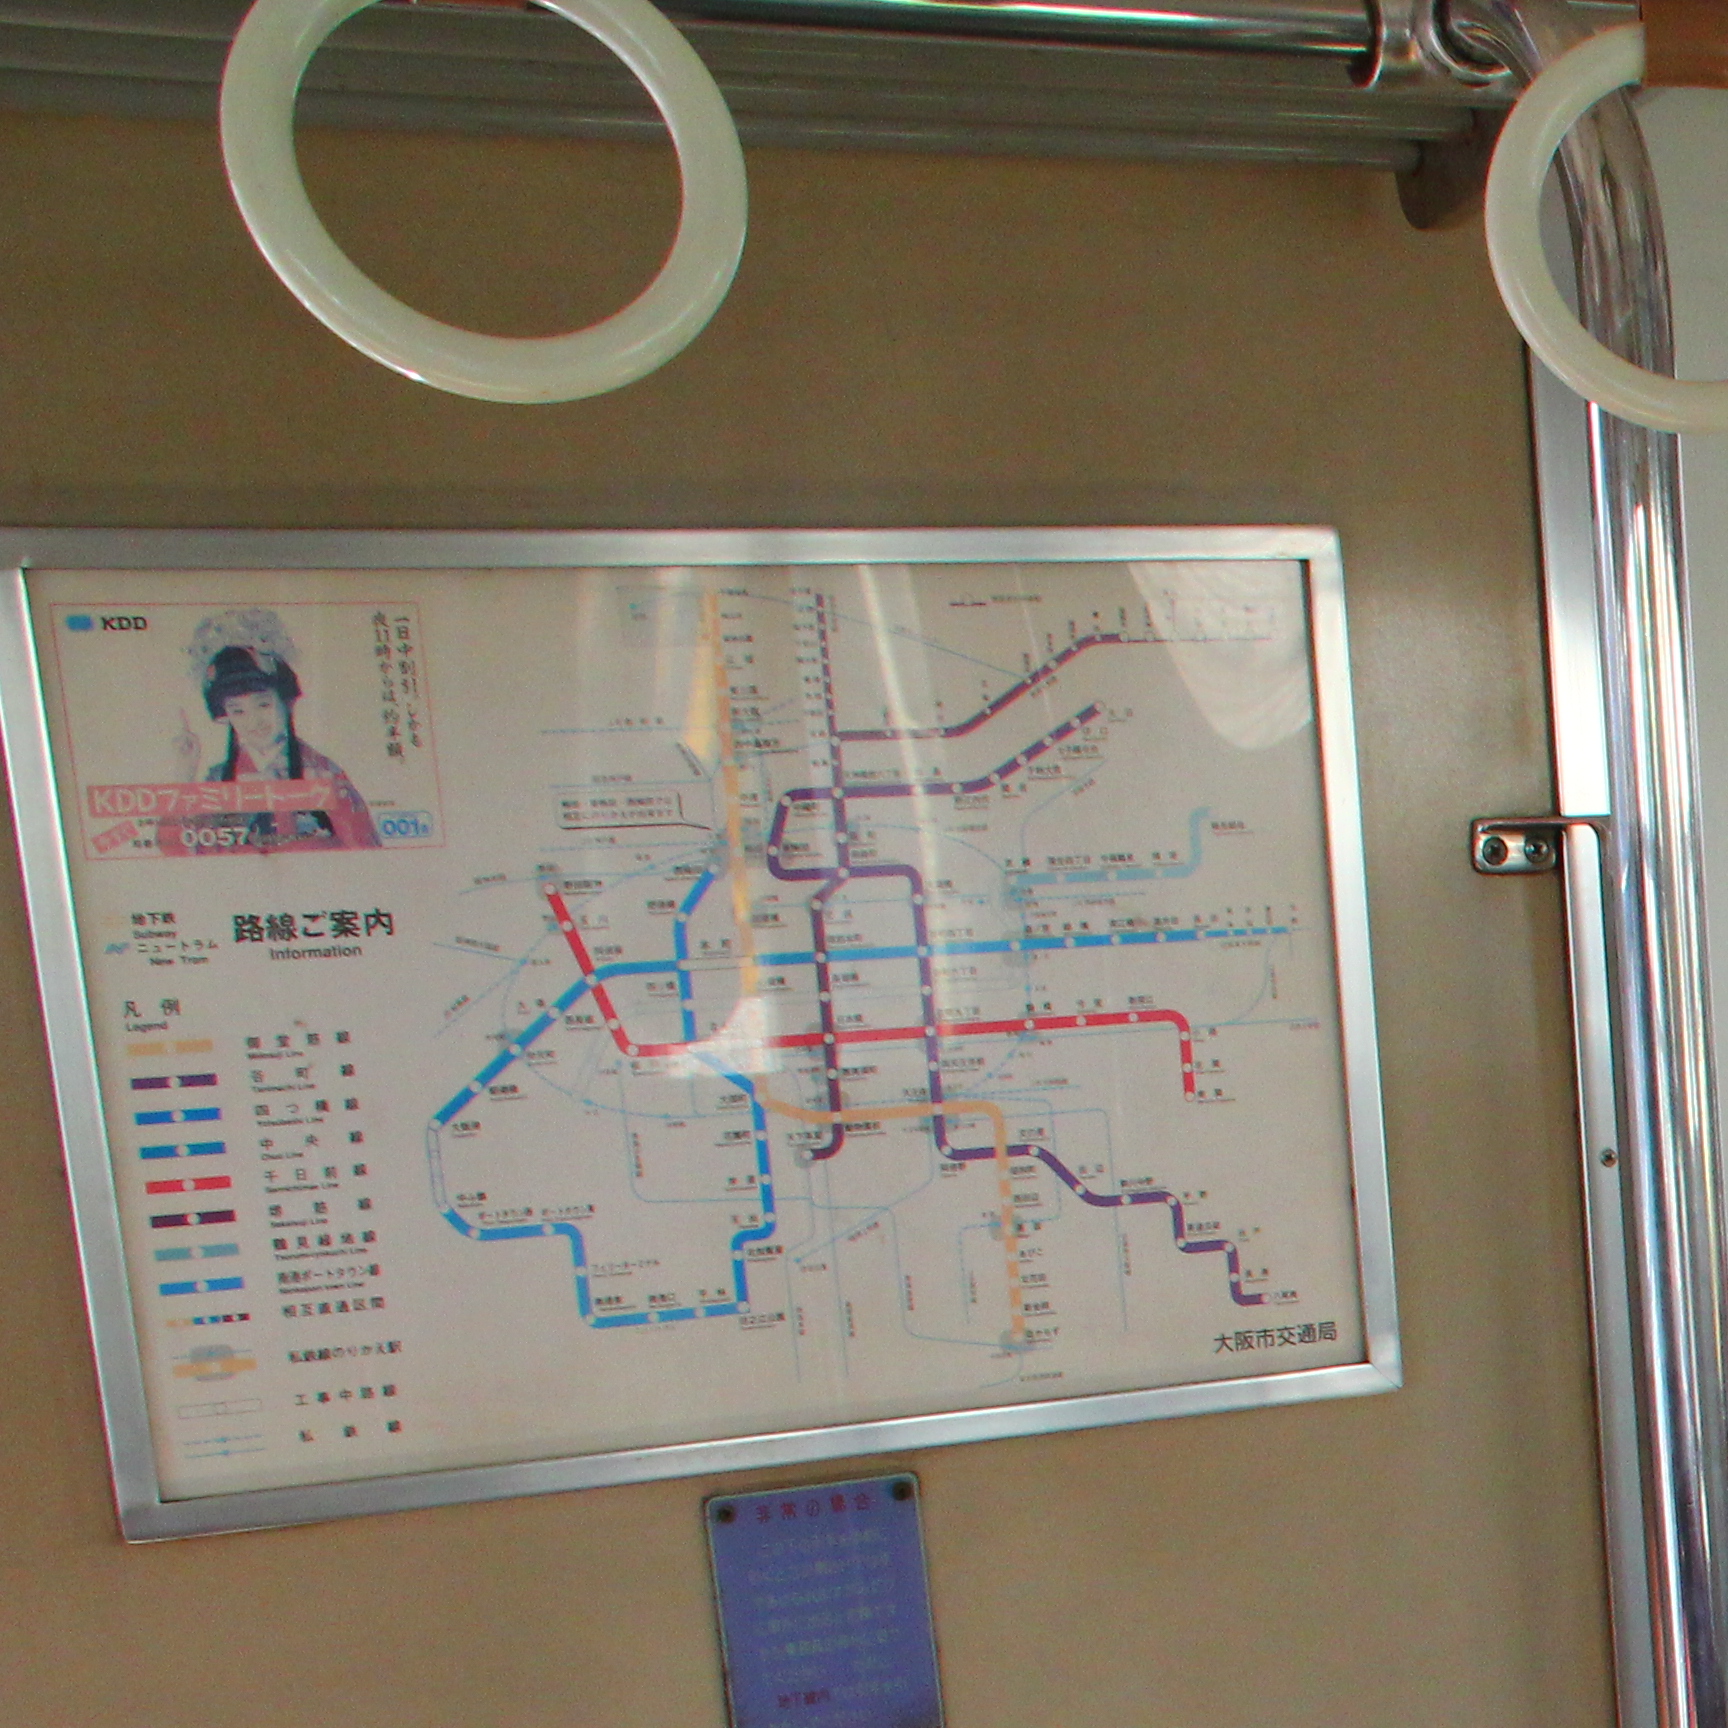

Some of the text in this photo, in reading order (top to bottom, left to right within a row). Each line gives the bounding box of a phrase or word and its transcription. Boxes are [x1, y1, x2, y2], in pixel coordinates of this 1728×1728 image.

[101, 615, 148, 631] KDD
[92, 783, 331, 813] KDDファミリートーク
[180, 826, 250, 847] 0057
[131, 911, 176, 925] 地下鉄
[232, 908, 395, 943] 路線ご案内
[137, 939, 219, 954] ニュートラム
[270, 944, 363, 961] Information
[1213, 1321, 1338, 1355] 大阪市交通局
